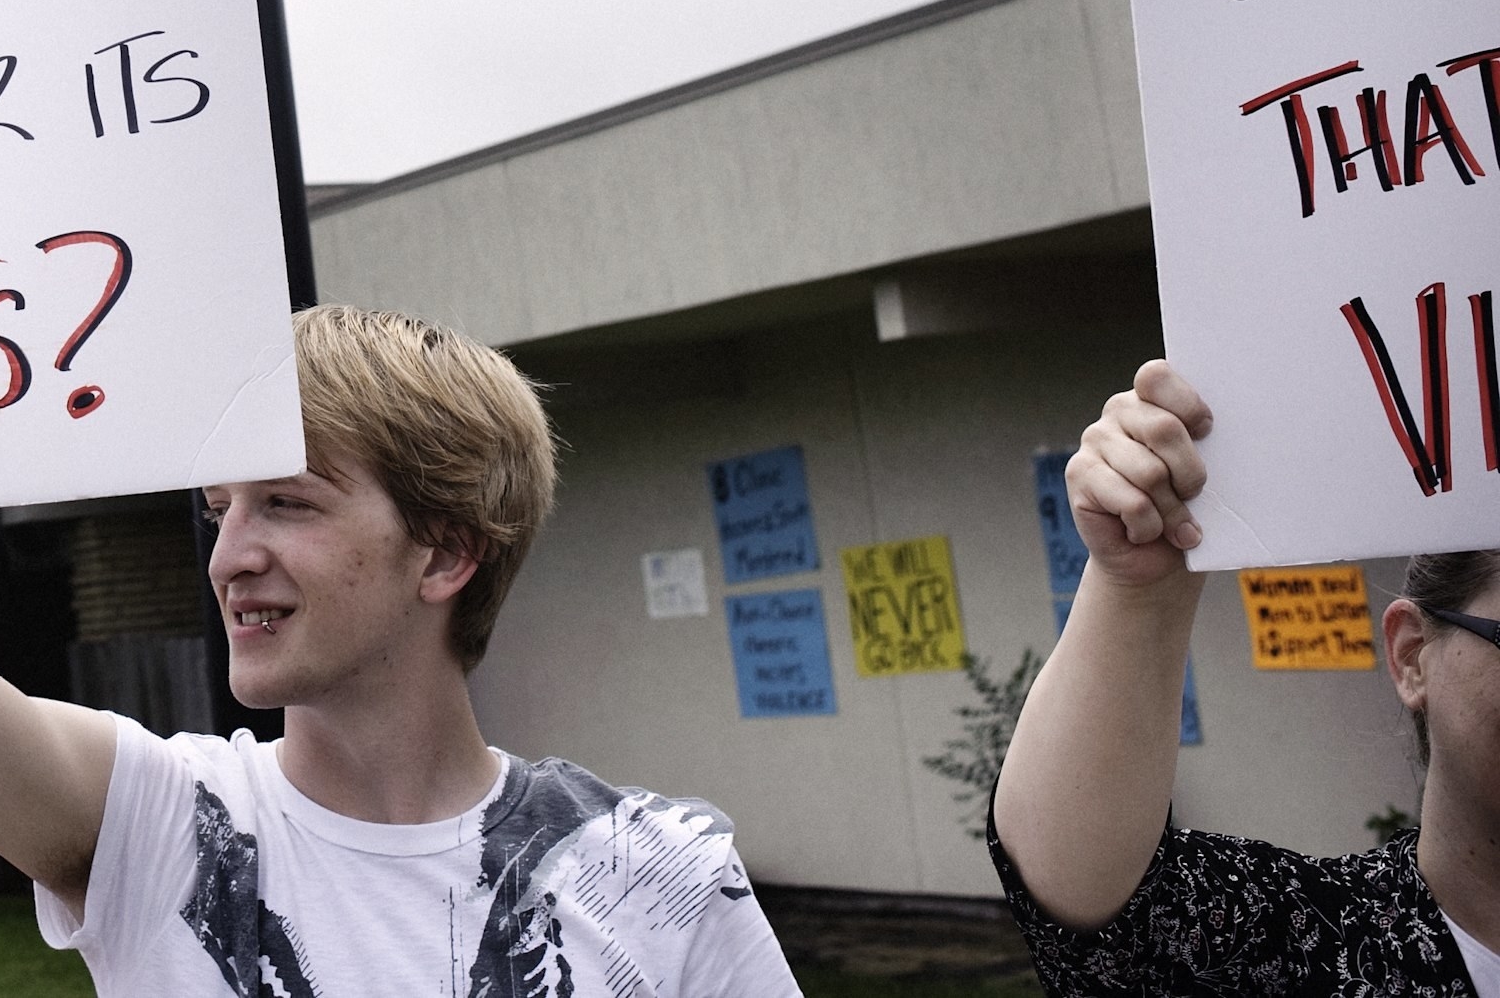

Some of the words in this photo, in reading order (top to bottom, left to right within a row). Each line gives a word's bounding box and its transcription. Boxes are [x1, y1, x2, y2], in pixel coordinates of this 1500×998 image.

[85, 29, 212, 140] ITS
[844, 549, 884, 583] WE
[886, 541, 935, 577] WILL
[849, 575, 954, 640] NEVER
